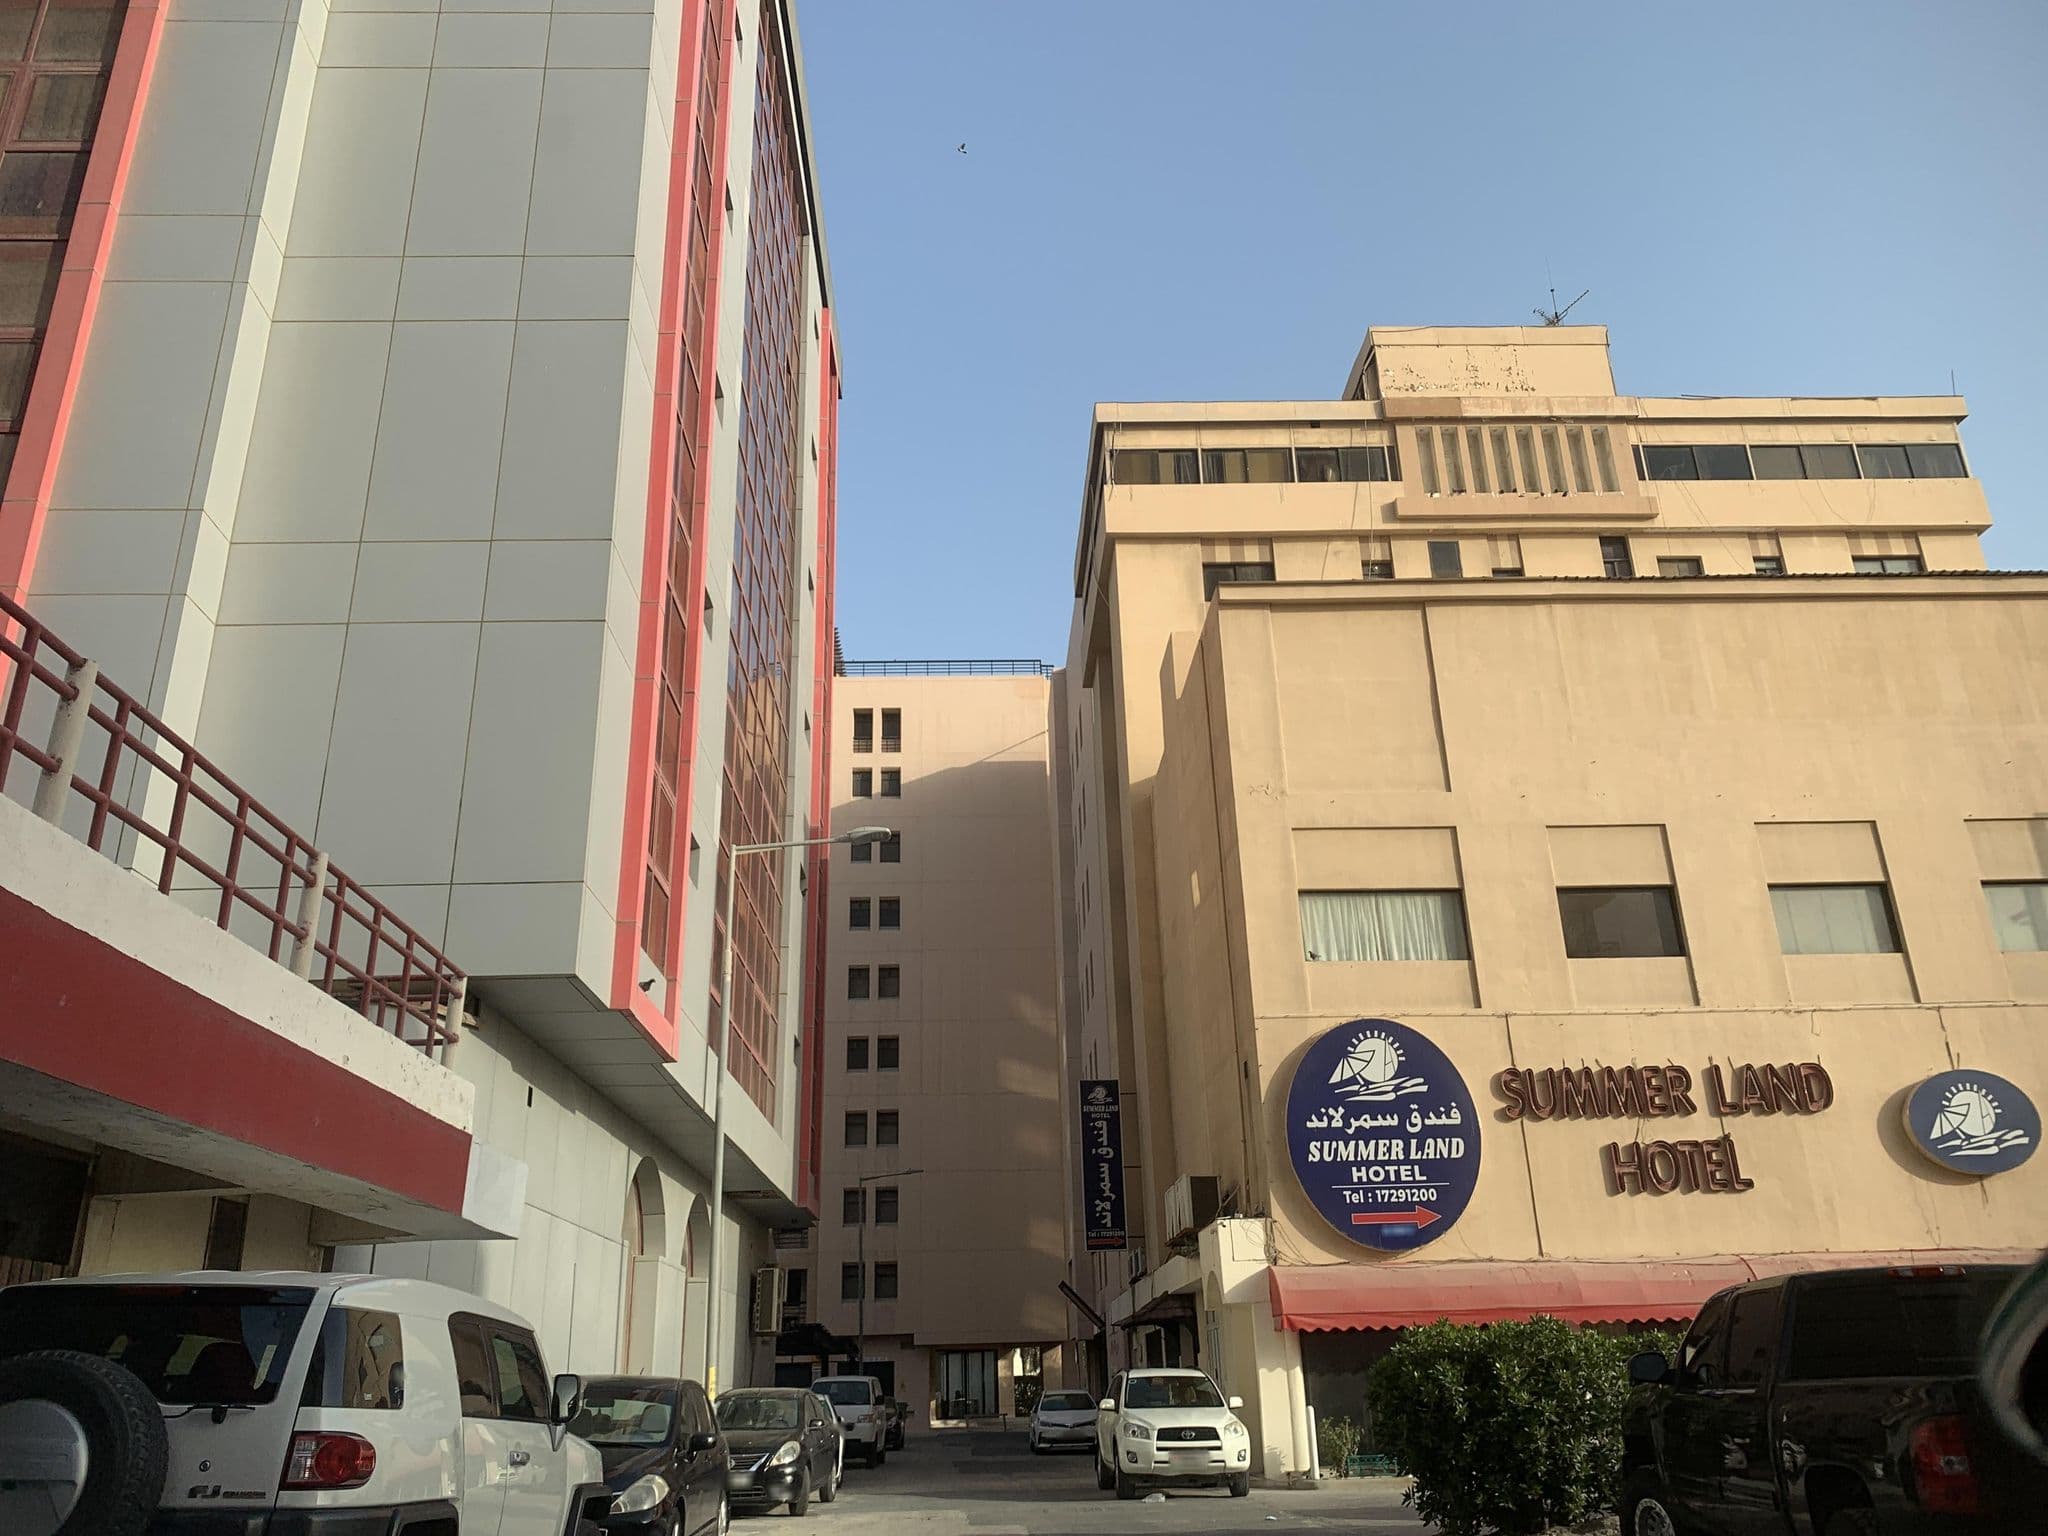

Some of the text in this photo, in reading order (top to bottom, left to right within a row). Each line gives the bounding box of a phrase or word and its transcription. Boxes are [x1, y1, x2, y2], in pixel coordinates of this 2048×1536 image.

[1500, 1063, 1834, 1119] SUMMER LAND
[1406, 1102, 1462, 1133] فندق
[1308, 1138, 1465, 1162] SUMMER LAND
[1352, 1165, 1427, 1183] HOTEL
[1609, 1139, 1754, 1193] HOTEL
[1343, 1190, 1364, 1204] Tel
[1376, 1188, 1437, 1202] 17291200
